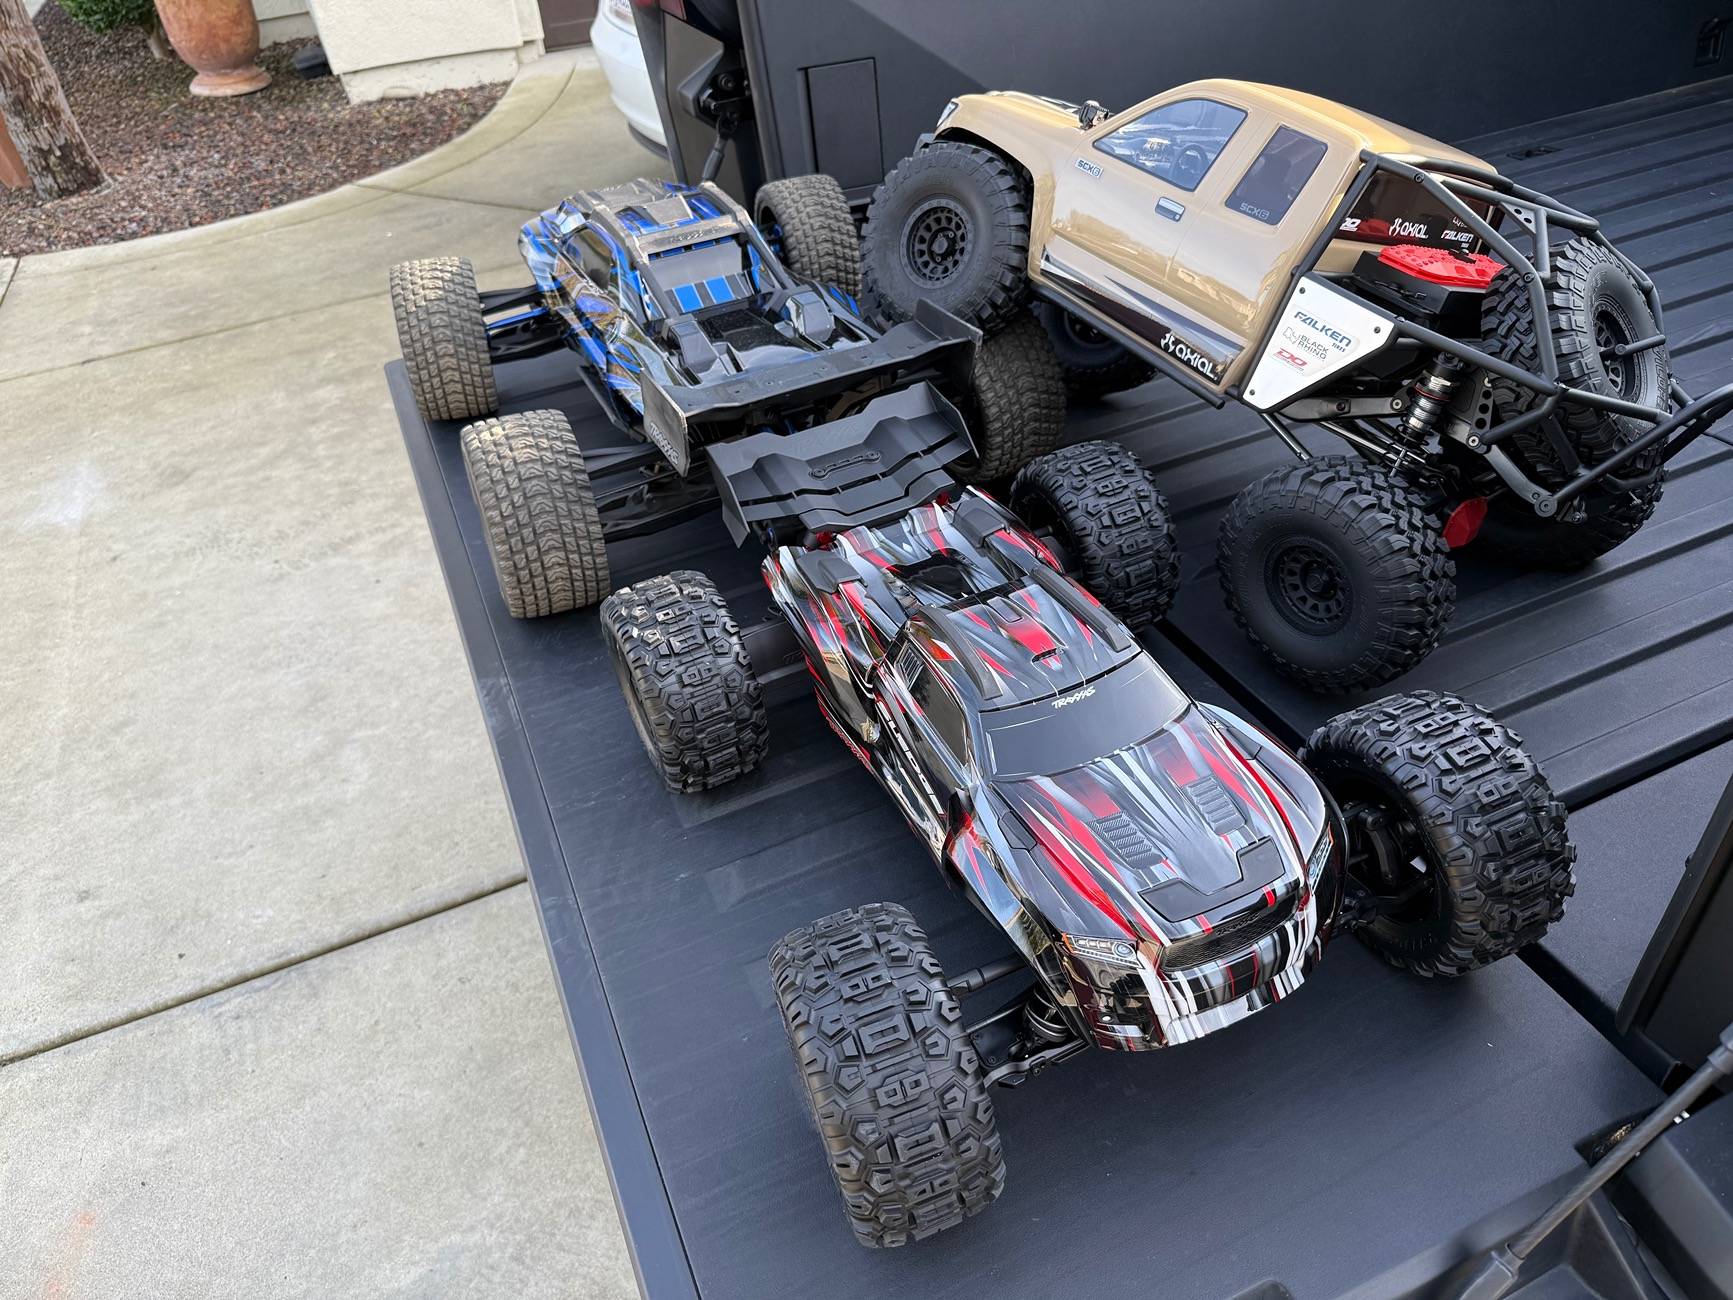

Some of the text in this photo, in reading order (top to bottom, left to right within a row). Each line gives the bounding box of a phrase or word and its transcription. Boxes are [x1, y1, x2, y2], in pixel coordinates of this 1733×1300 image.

[1441, 230, 1474, 243] FALKEN
[1294, 310, 1352, 347] FALKEN
[1298, 340, 1328, 360] RHINO
[1300, 335, 1330, 354] BLACK
[1175, 343, 1216, 379] AXIAL
[1051, 686, 1096, 709] TRAXXAS
